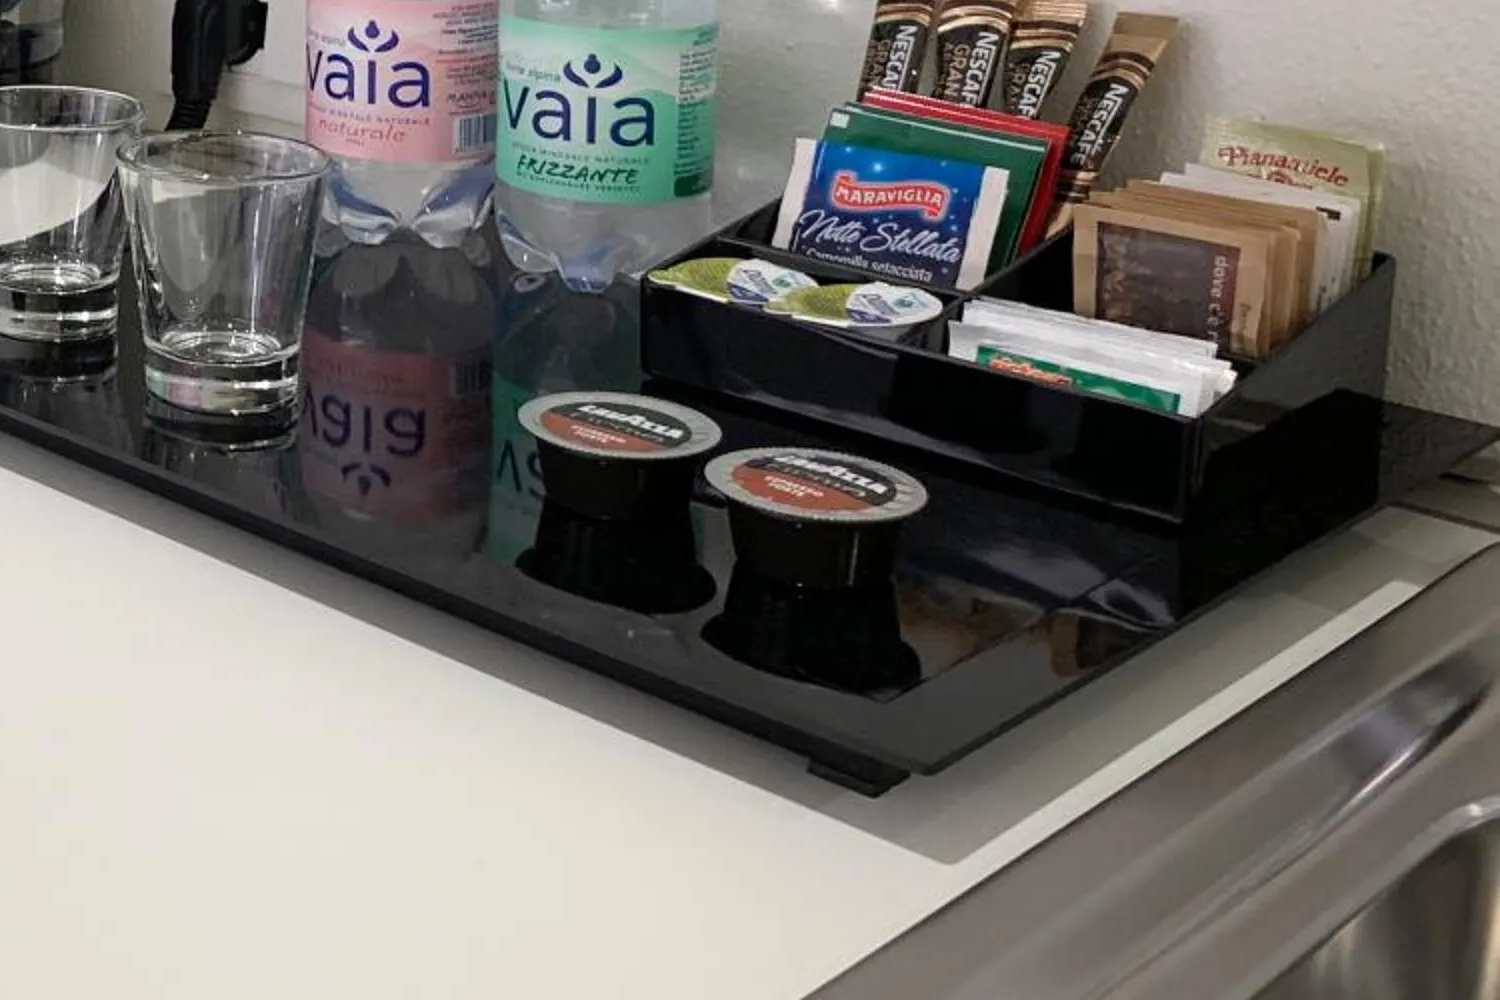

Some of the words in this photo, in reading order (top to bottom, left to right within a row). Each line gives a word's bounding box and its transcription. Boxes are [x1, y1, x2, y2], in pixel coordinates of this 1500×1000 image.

[881, 25, 918, 89] NESCA
[944, 44, 970, 97] GRAN
[961, 31, 999, 104] NESCAF
[1018, 51, 1061, 117] NESCAF
[319, 119, 406, 143] naturale
[502, 77, 656, 147] vaia
[517, 154, 640, 185] FRIZZANTE
[835, 185, 942, 208] MARAVIGLIA
[800, 210, 866, 246] Notte
[860, 222, 961, 263] Stellata
[577, 405, 684, 439] LAVAZZA
[774, 456, 887, 494] LAVAZZA
